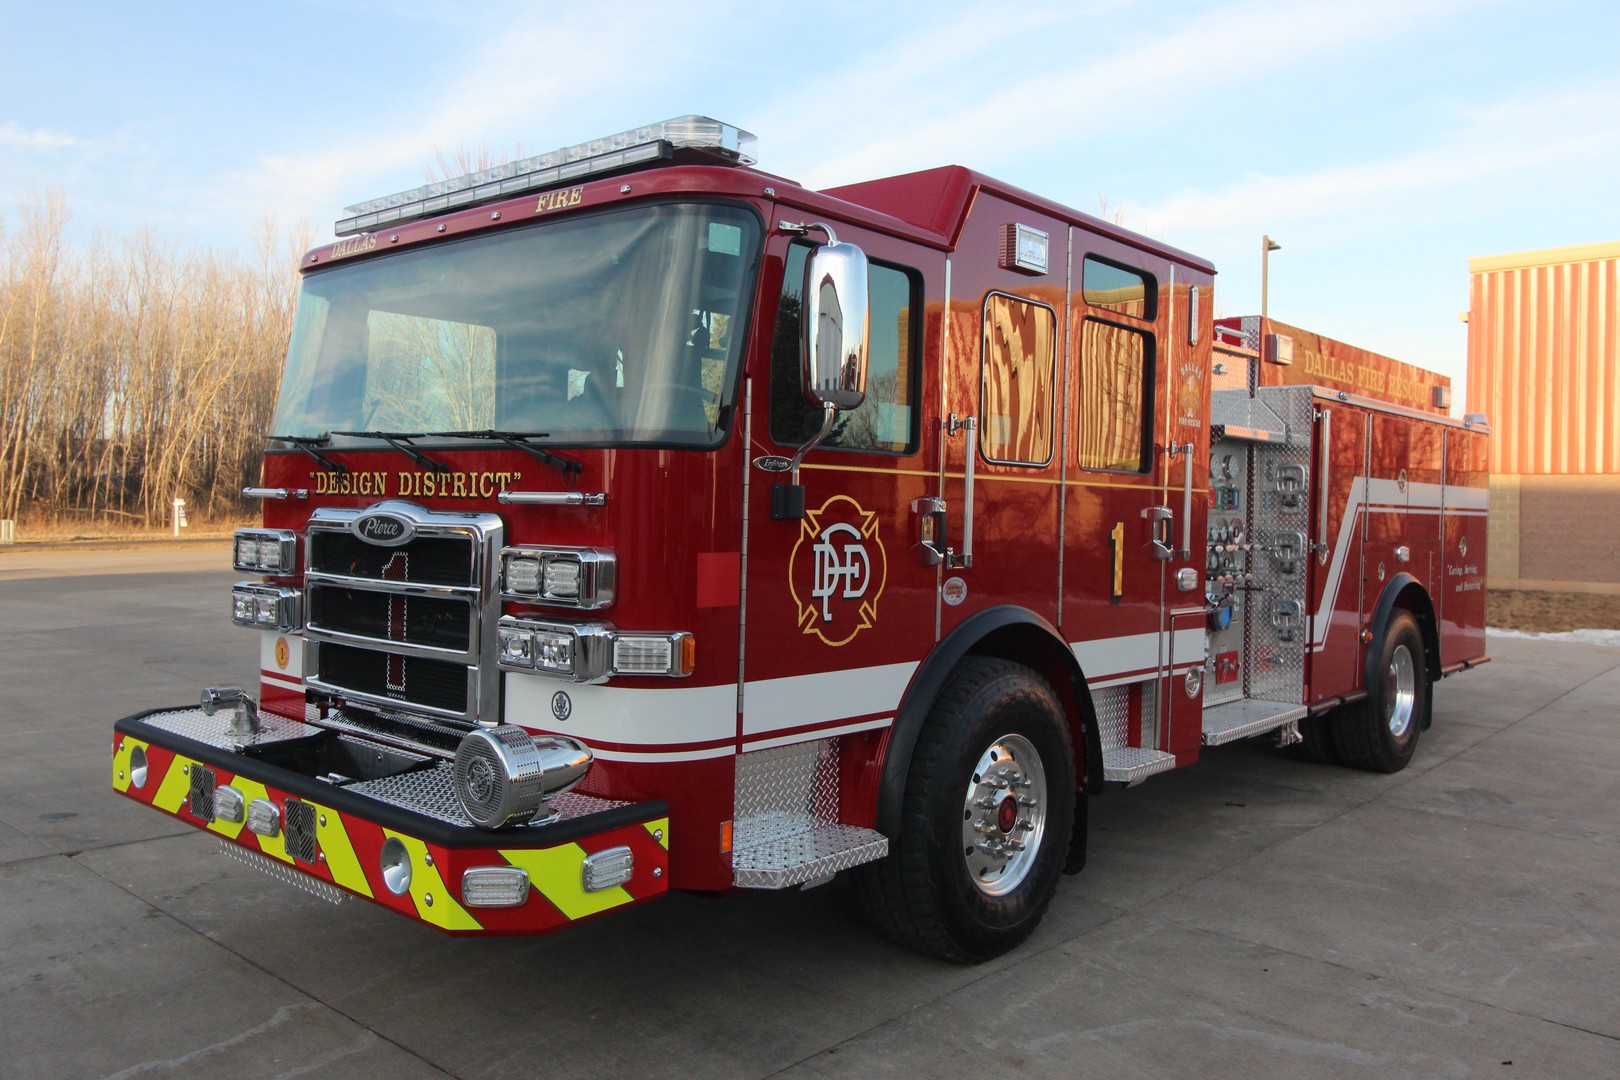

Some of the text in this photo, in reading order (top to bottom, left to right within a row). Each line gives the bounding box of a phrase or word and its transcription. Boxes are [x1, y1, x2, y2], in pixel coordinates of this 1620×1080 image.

[331, 186, 584, 258] DALLAS FIRE
[1180, 362, 1202, 379] DALLAS
[1304, 349, 1430, 402] DALLAS FIRE RESCUE
[364, 517, 400, 537] Pierce
[1111, 522, 1124, 596] 1
